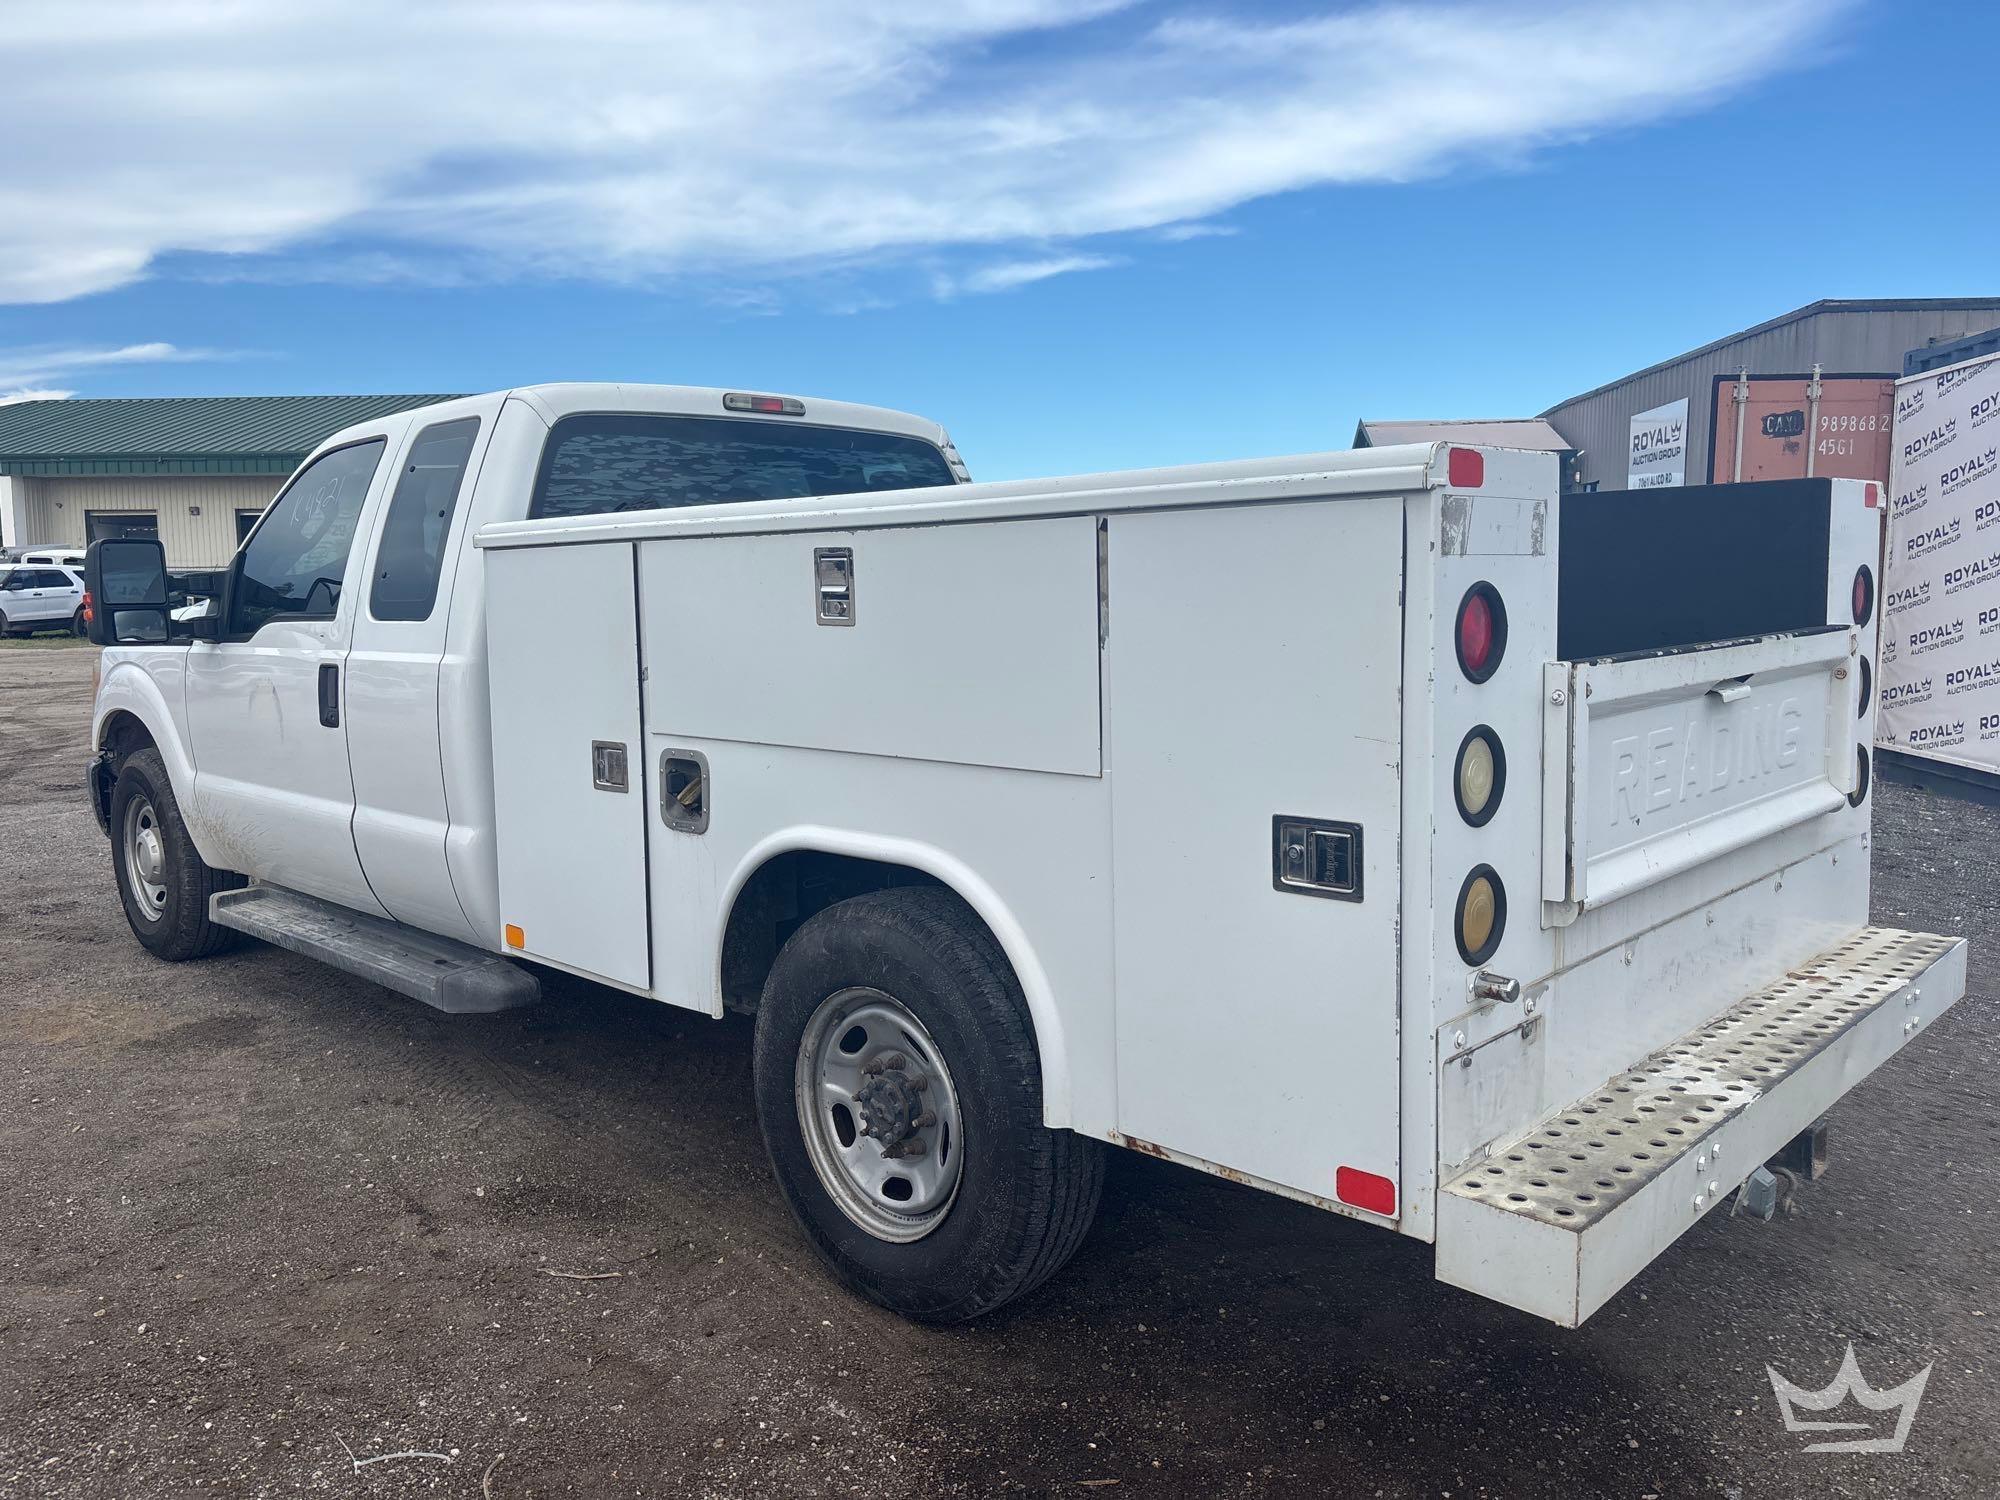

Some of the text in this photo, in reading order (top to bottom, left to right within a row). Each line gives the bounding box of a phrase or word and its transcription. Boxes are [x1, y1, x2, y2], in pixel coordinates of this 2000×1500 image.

[1938, 375, 1967, 398] AUCTION
[1902, 403, 1924, 422] GROUP
[1971, 392, 2000, 419] ROY
[1972, 407, 2000, 429] AUCTIO
[1632, 425, 1670, 453] ROYAL
[1818, 438, 1853, 455] 45G1
[1904, 426, 1945, 458] ROYAL
[1905, 432, 1957, 467] AUCTION GROUP
[1632, 446, 1681, 466] AUCTION GROUP
[1940, 456, 1985, 487] ROYAL
[1941, 463, 1998, 497] AUCTION GROUP
[1893, 491, 1917, 510] YAL
[1905, 499, 1928, 515] GROUP
[1907, 524, 1949, 552] ROYAL
[1907, 533, 1961, 561] AUCTION GROUP
[1944, 559, 1989, 586] ROYAL
[1887, 586, 1919, 607] OYAL
[1945, 579, 1975, 596] AUCTION
[1887, 595, 1931, 616] CTION GROUP
[1910, 624, 1952, 647] ROYAL
[1910, 634, 1964, 656] AUCTION GROUP
[1946, 664, 1991, 686] ROYAL
[1946, 676, 2000, 695] AUCTION GROU
[1881, 682, 1921, 701] ROYAL
[1882, 693, 1932, 710] AUCTION GROUP
[1909, 724, 1953, 742] ROYAL
[1940, 736, 1965, 748] GROUP
[1980, 730, 2000, 741] AUCT
[1610, 697, 1802, 827] READING
